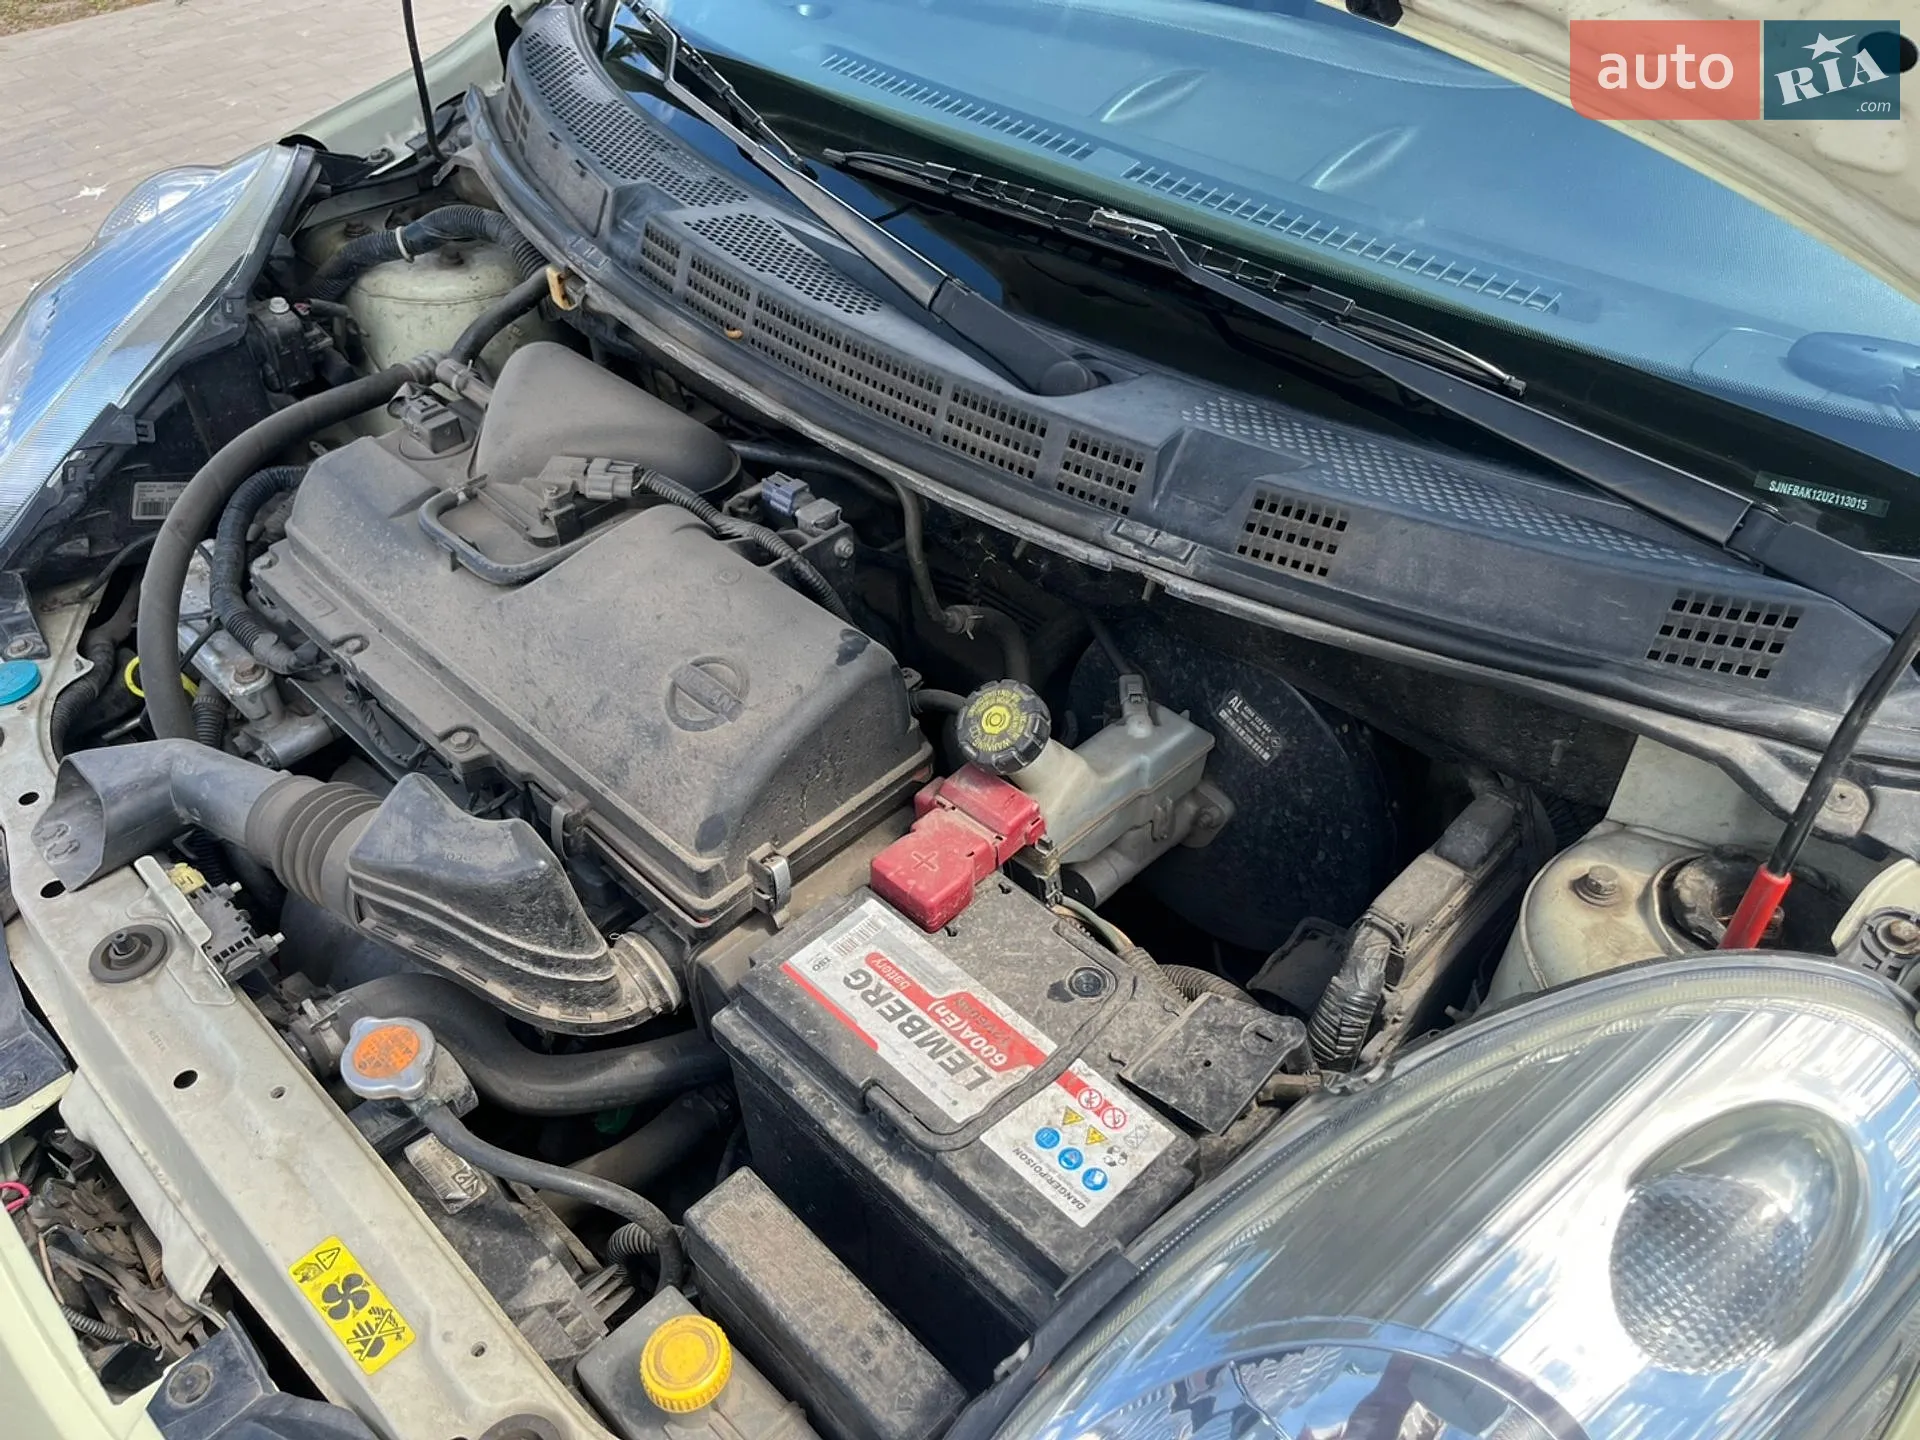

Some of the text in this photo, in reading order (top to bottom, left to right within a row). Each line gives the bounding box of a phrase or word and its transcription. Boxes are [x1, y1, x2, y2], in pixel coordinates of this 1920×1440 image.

[1769, 480, 1868, 511] SJNFBAK12U2113015
[1228, 696, 1243, 713] AL
[871, 958, 912, 990] battery
[843, 968, 992, 1091] LEMBERG
[927, 1000, 1007, 1066] 600A(En)
